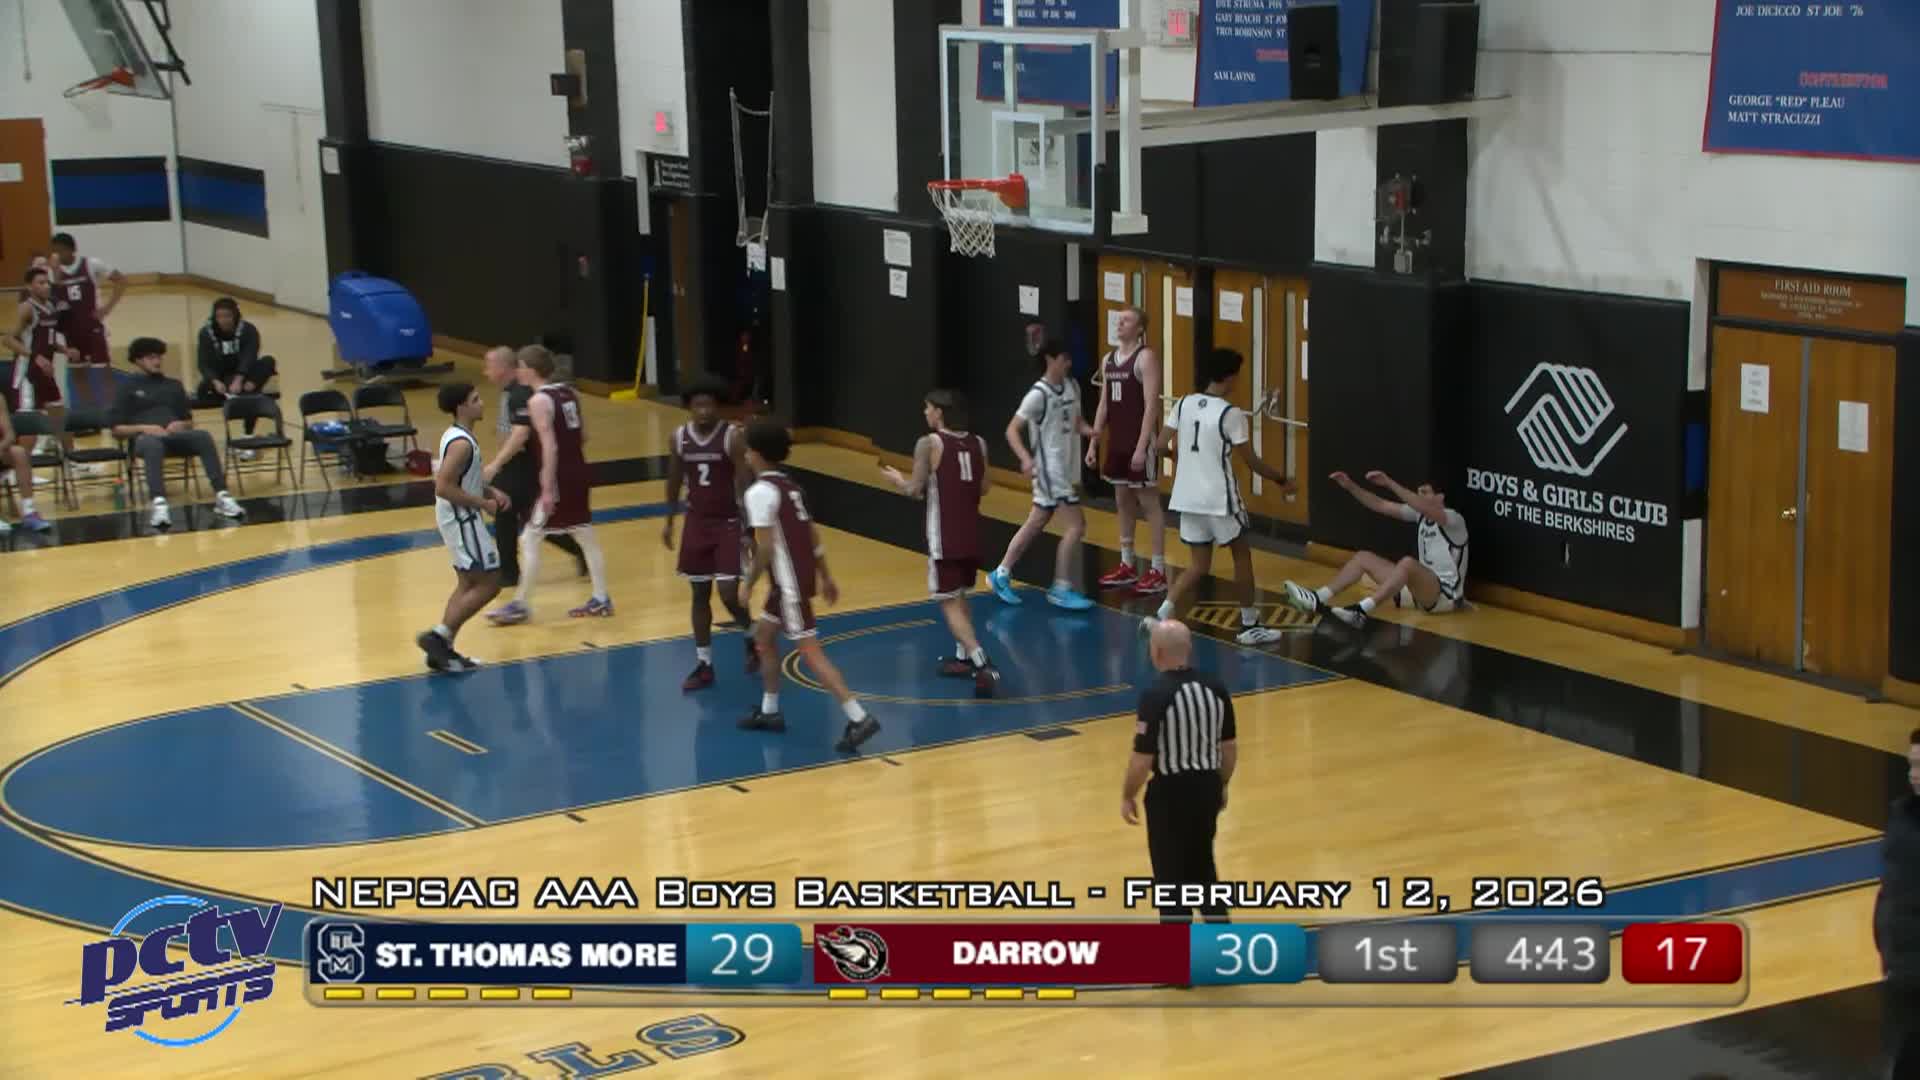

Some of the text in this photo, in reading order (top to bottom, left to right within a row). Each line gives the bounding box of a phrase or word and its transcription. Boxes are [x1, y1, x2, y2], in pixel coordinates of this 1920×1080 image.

[1736, 5, 1754, 17] JOE
[1758, 5, 1800, 16] DICICCO
[1806, 5, 1820, 16] ST
[1823, 5, 1842, 16] JOE
[1213, 71, 1229, 81] SAM
[1728, 95, 1772, 107] GEORGE
[1810, 96, 1845, 109] PLEAU
[1728, 111, 1821, 125] MATT STRACUZZI
[1775, 279, 1851, 297] FIRST AID ROOM
[1190, 420, 1201, 453] 1
[697, 463, 711, 486] 2
[957, 451, 973, 482] 11
[1467, 468, 1668, 526] BOYS & GIRLS CLUB
[1494, 499, 1635, 543] OF THE BERKSHIRES
